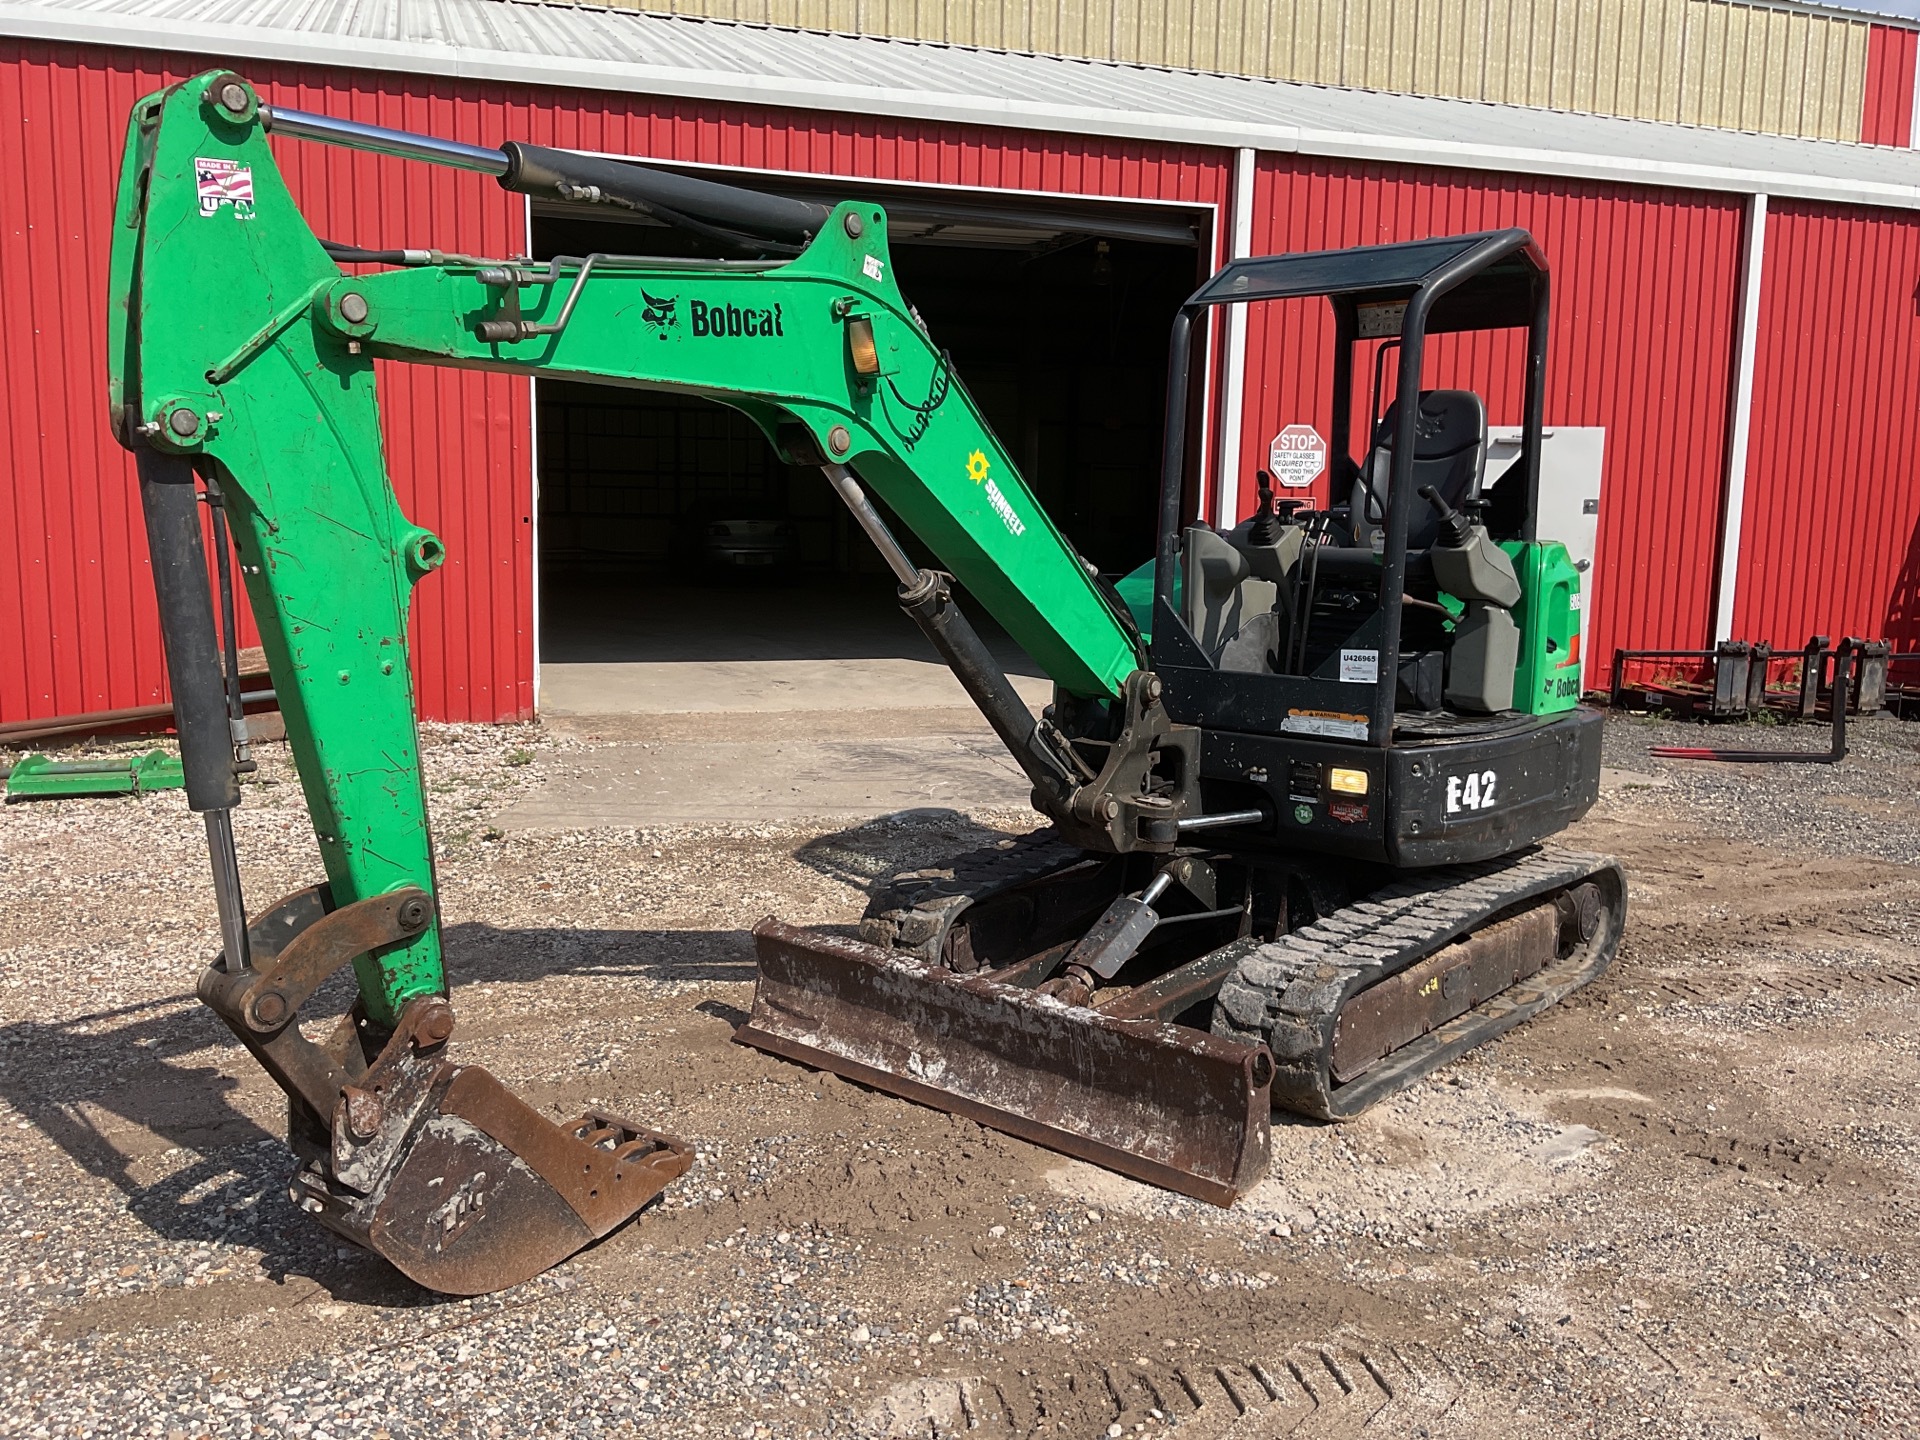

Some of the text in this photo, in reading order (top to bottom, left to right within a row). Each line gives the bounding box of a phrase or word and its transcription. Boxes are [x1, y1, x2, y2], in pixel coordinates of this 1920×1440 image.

[199, 161, 222, 170] MADE
[690, 299, 784, 338] Bobcat
[1280, 434, 1318, 450] STOP
[1274, 451, 1315, 460] SAFETY GLASSES
[984, 478, 1026, 536] SUNBELT
[1343, 654, 1376, 663] U426965
[1556, 677, 1580, 698] Bobca
[1315, 711, 1341, 719] WARNING
[1446, 770, 1496, 812] E42
